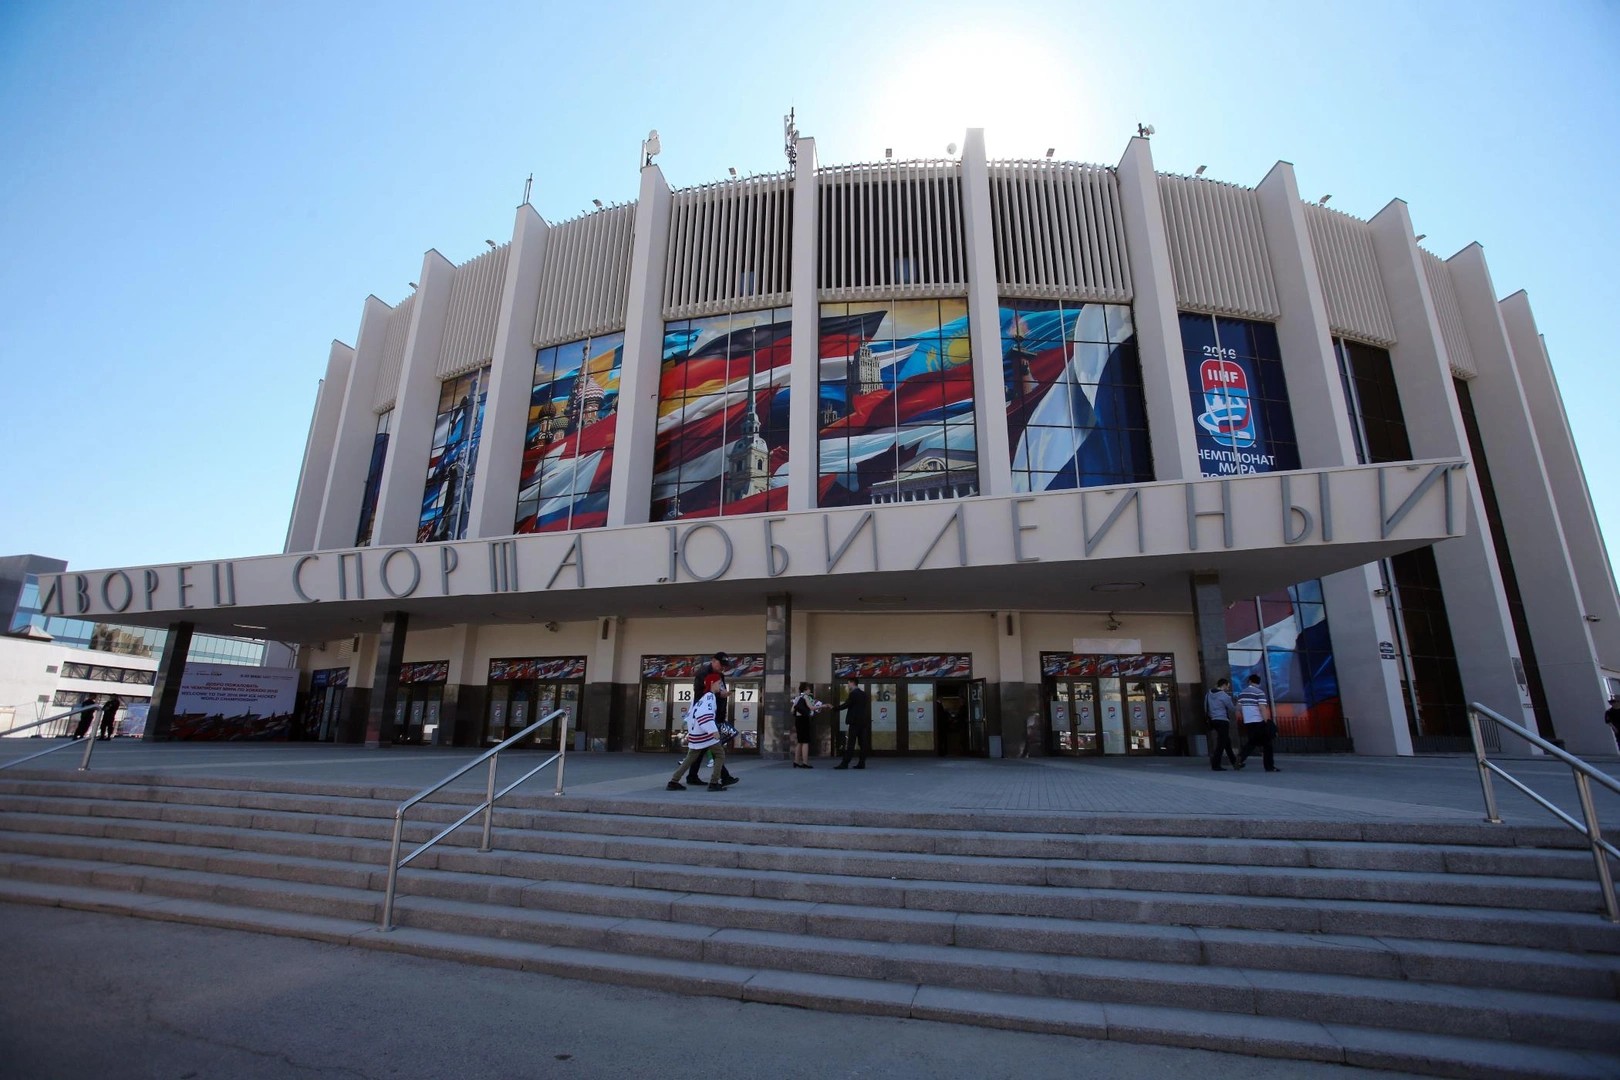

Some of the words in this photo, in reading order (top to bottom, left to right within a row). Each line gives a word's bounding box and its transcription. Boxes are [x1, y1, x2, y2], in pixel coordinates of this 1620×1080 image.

[1207, 369, 1239, 383] IIHF
[1218, 462, 1257, 475] МИРА
[40, 562, 236, 615] ДВОРЕЦ
[292, 533, 585, 604] СПОРТА
[678, 690, 691, 701] 18
[739, 690, 753, 701] 17
[876, 690, 890, 702] 16
